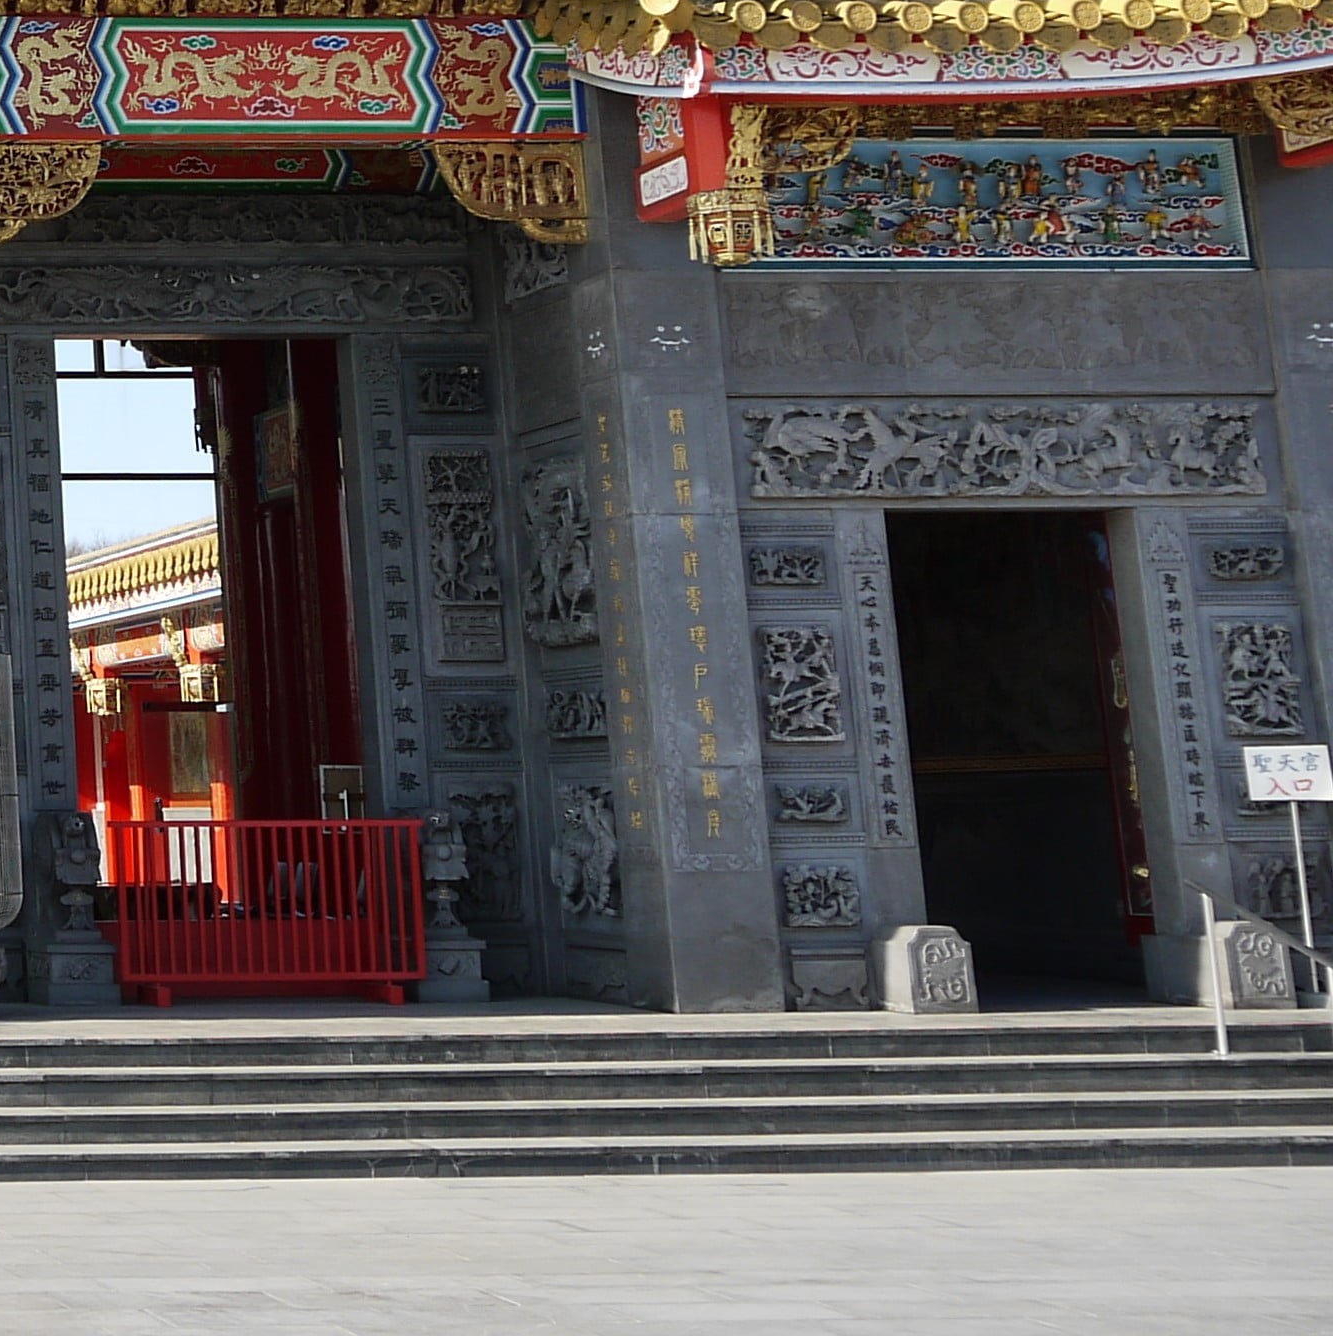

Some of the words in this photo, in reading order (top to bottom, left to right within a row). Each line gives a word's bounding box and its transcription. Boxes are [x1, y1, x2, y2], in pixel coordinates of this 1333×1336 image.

[1253, 752, 1320, 773] 聖天宮
[1267, 777, 1313, 796] 入口
